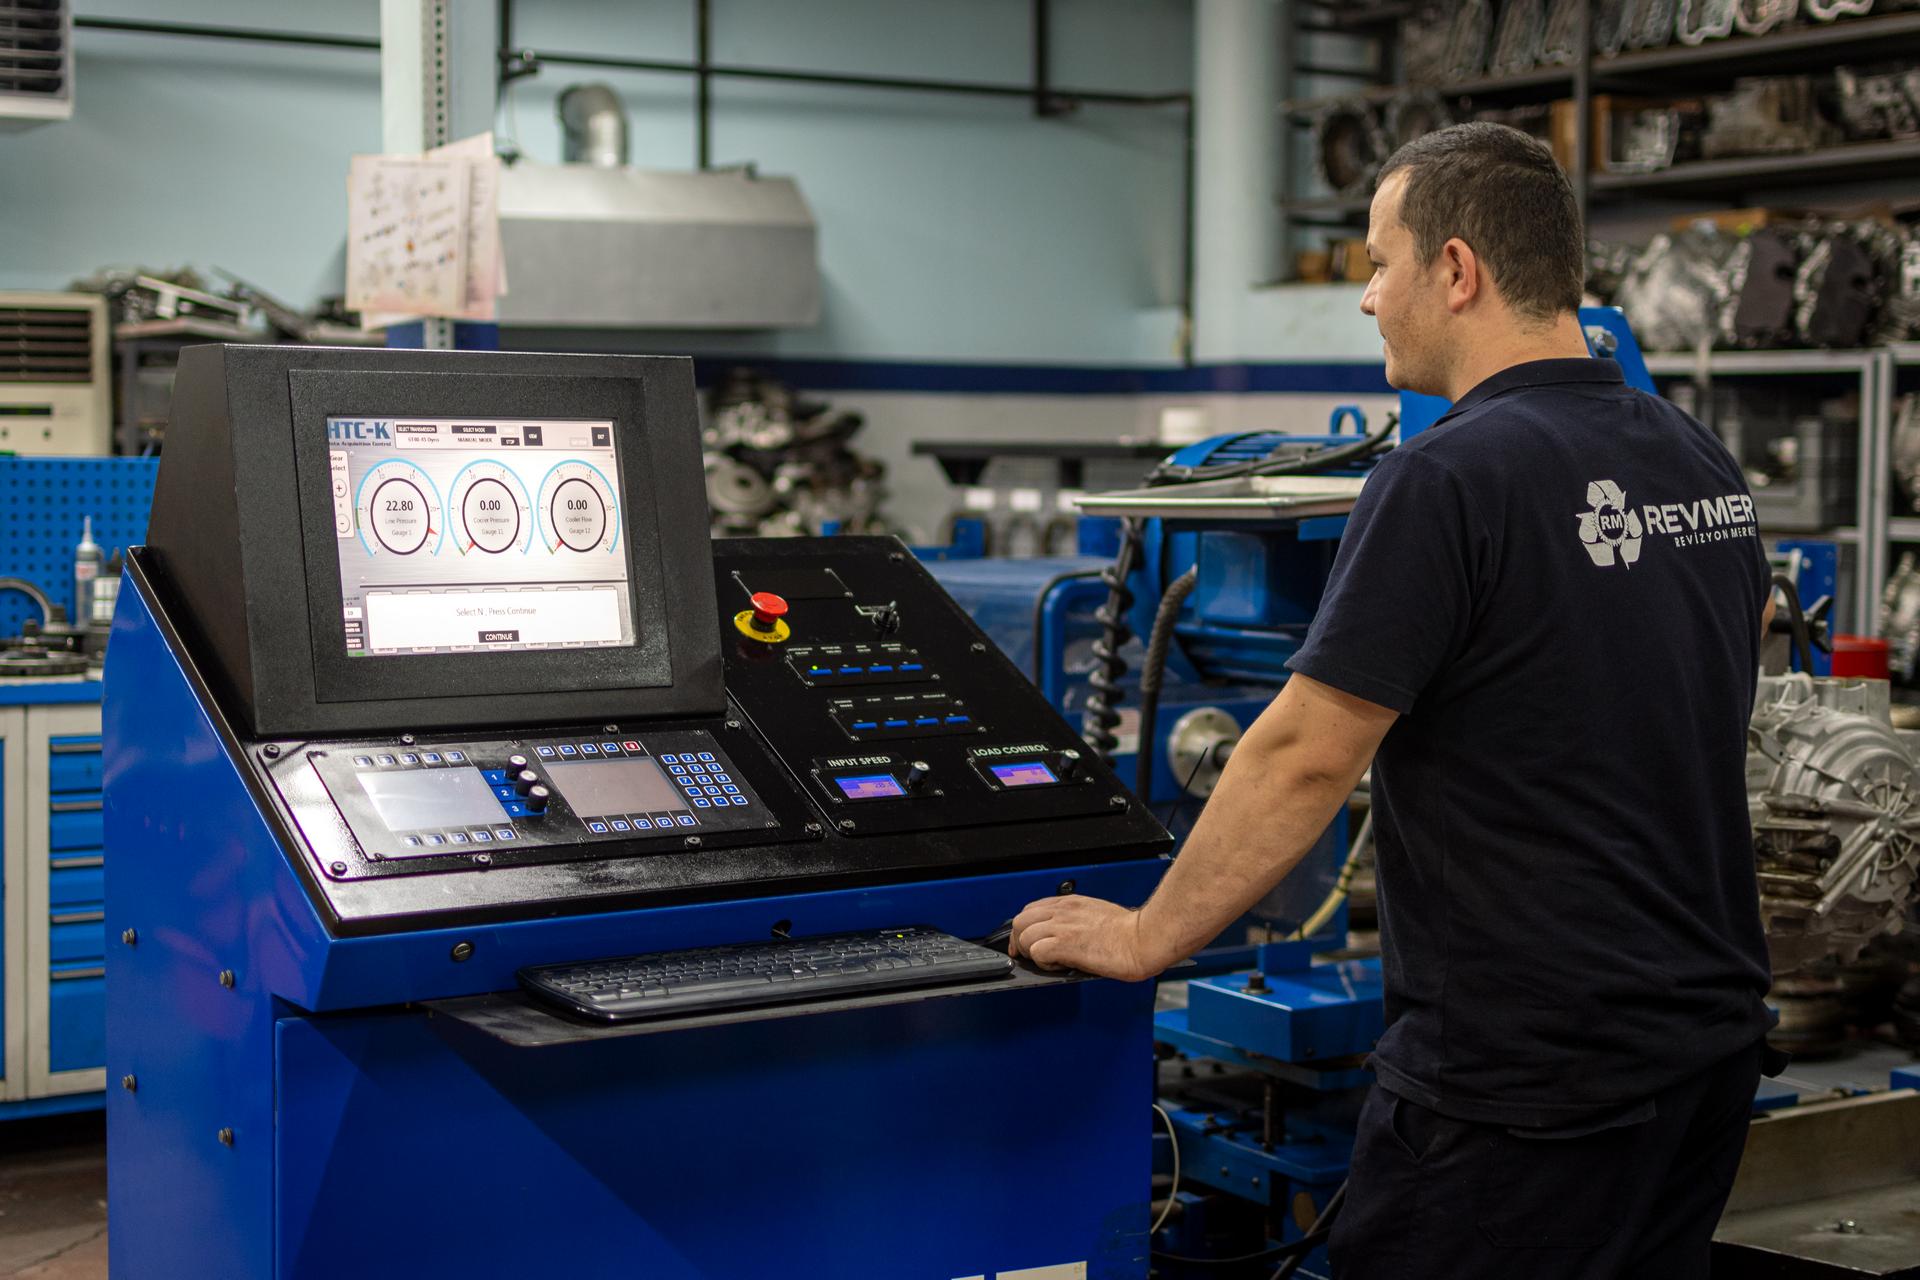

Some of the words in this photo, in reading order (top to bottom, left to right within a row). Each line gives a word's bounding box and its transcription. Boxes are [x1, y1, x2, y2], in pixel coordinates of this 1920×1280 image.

[328, 421, 390, 439] HTC-K
[386, 500, 414, 511] 22.80
[480, 500, 501, 511] 0.00
[568, 499, 588, 510] 0.00
[1642, 494, 1756, 535] REVMER
[1600, 515, 1623, 531] RM
[1674, 529, 1729, 548] REVİZYON
[456, 608, 476, 617] Select
[489, 607, 506, 616] Press
[507, 606, 537, 615] Continue
[485, 633, 513, 641] CONTINUE
[973, 748, 1002, 757] LOAD
[1002, 744, 1049, 754] CONTROL
[828, 757, 859, 767] INPUT
[859, 756, 891, 765] SPEED
[501, 789, 509, 797] 2
